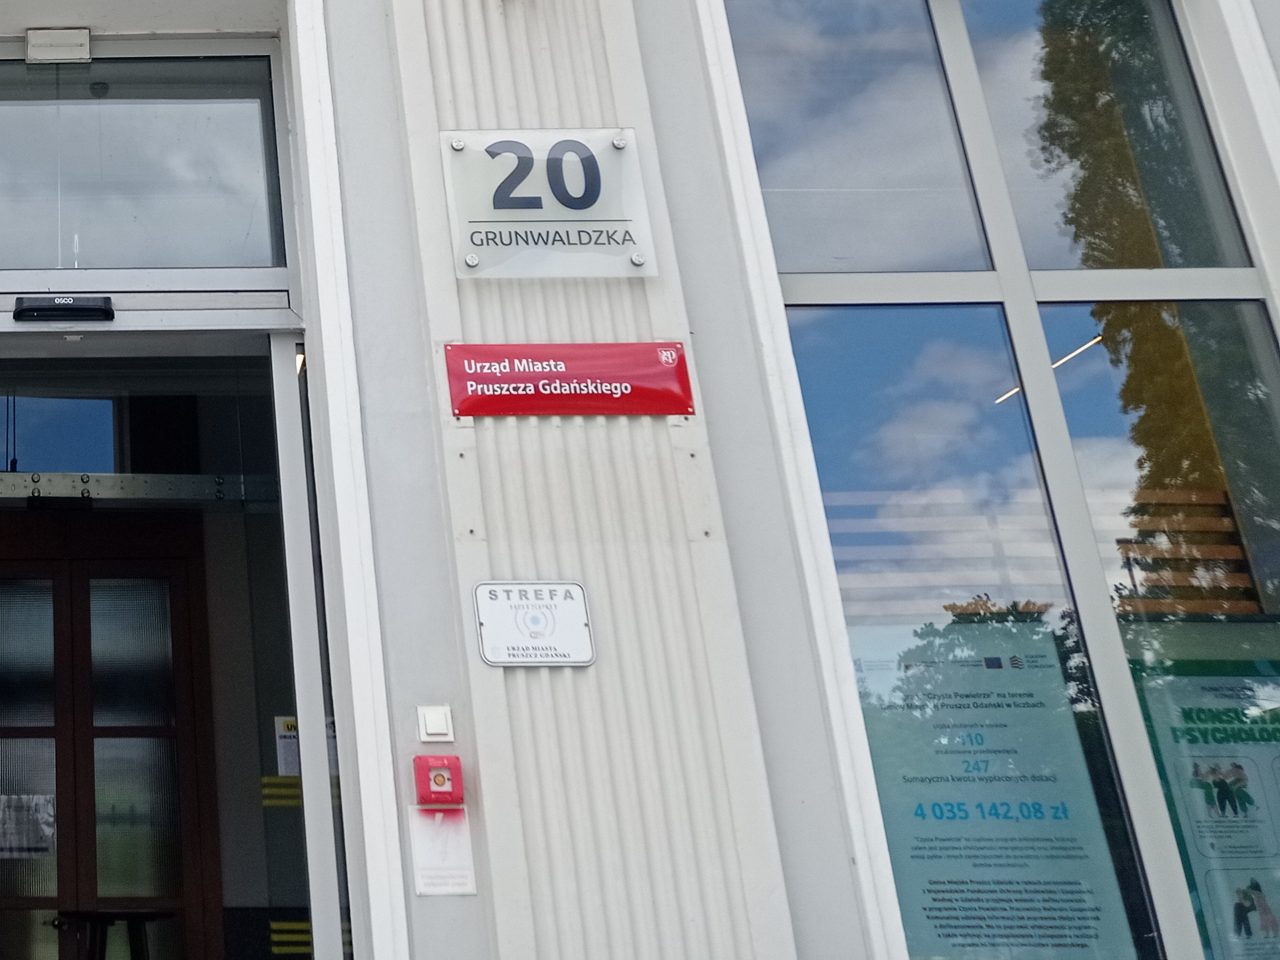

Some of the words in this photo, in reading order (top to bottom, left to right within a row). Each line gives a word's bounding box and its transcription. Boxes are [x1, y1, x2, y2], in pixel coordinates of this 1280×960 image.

[484, 139, 602, 211] 20
[469, 229, 637, 246] GRUNWALDZKA
[464, 358, 510, 376] Urząd
[514, 357, 566, 372] Miasta
[466, 380, 535, 395] Pruszcza
[538, 379, 632, 397] Gdańskiego
[488, 589, 575, 601] STREFA
[961, 759, 990, 774] 247
[913, 802, 927, 820] 4
[931, 802, 969, 820] 035
[975, 801, 1045, 822] 142,08
[1050, 801, 1069, 820] zł
